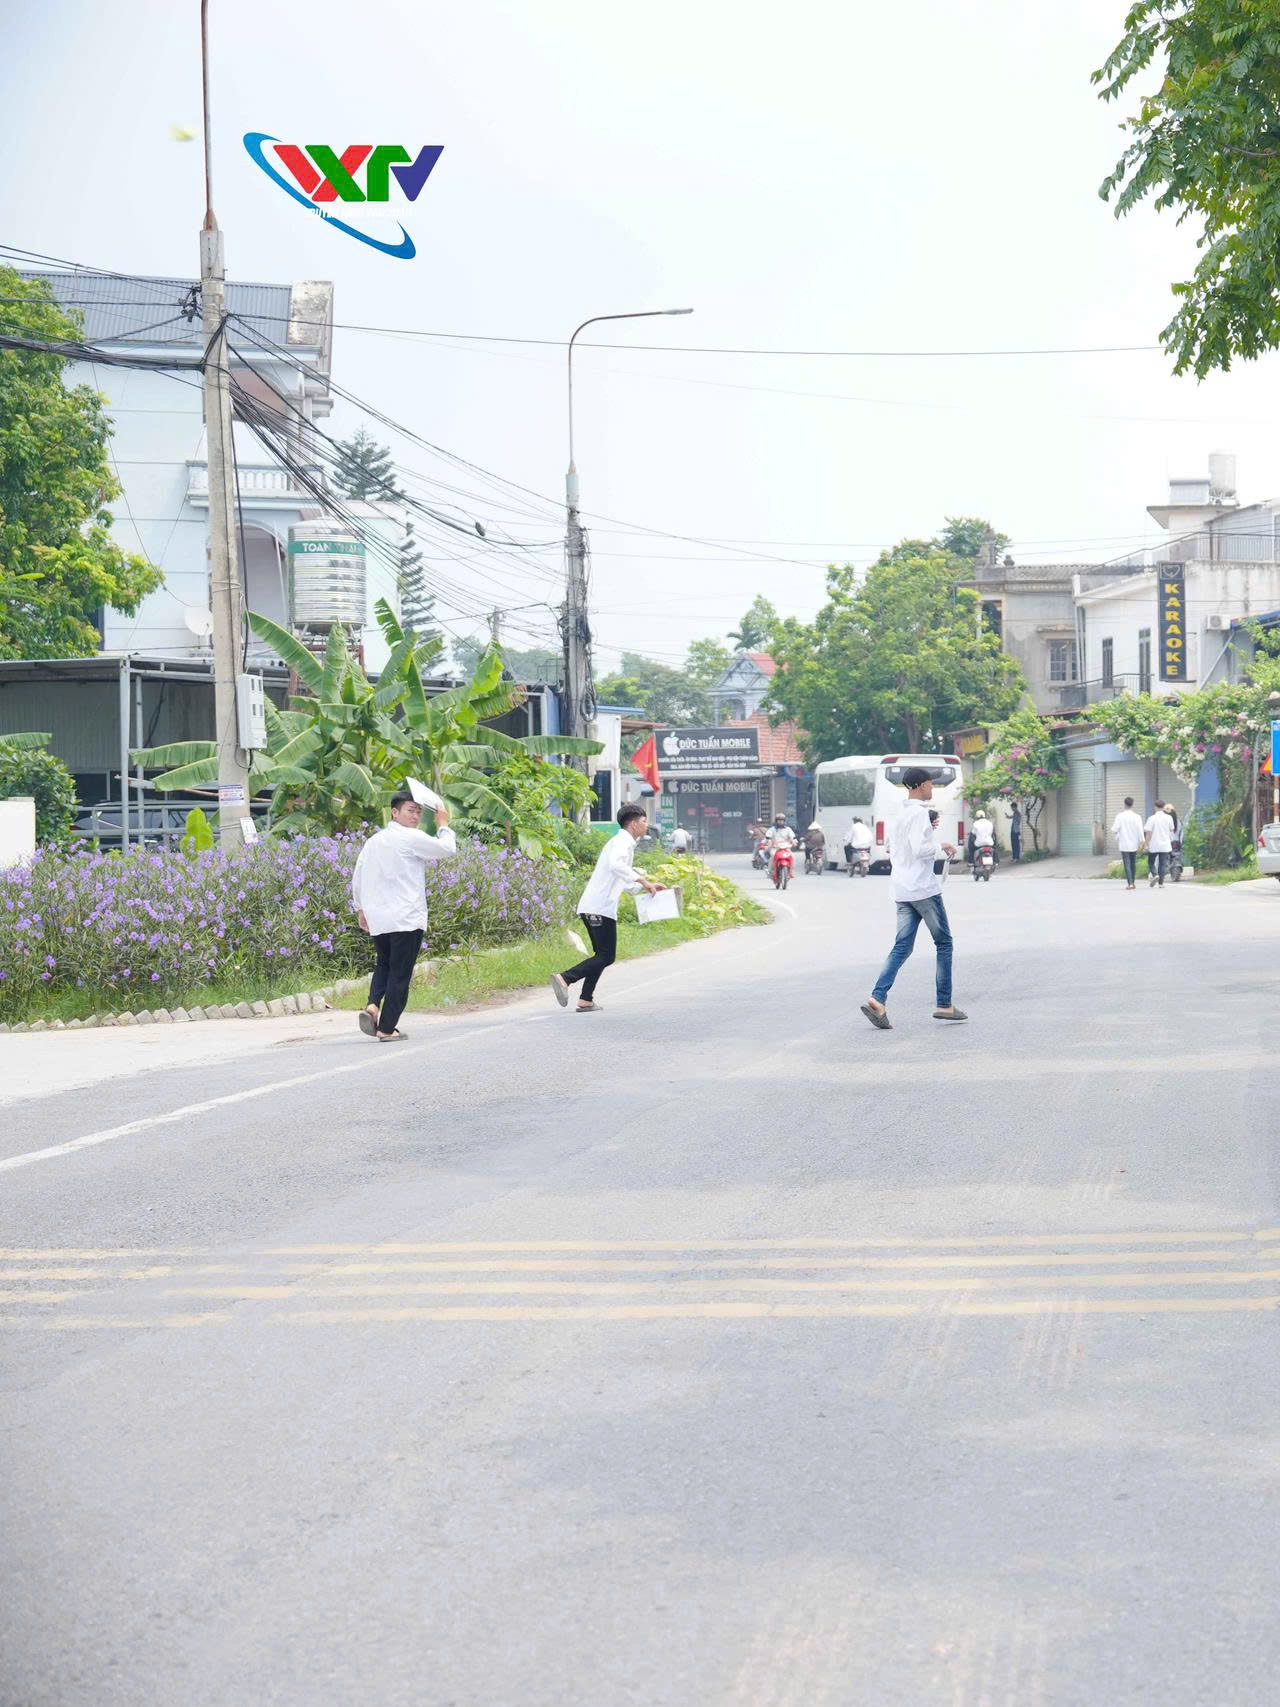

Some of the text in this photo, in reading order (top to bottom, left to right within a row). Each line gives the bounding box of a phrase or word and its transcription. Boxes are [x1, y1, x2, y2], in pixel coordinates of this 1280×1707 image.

[1164, 583, 1183, 676] KARAOKE
[680, 735, 751, 748] ĐỨC TUẤN MOBILE
[681, 779, 757, 792] ĐỨC TUẤN MOBILE
